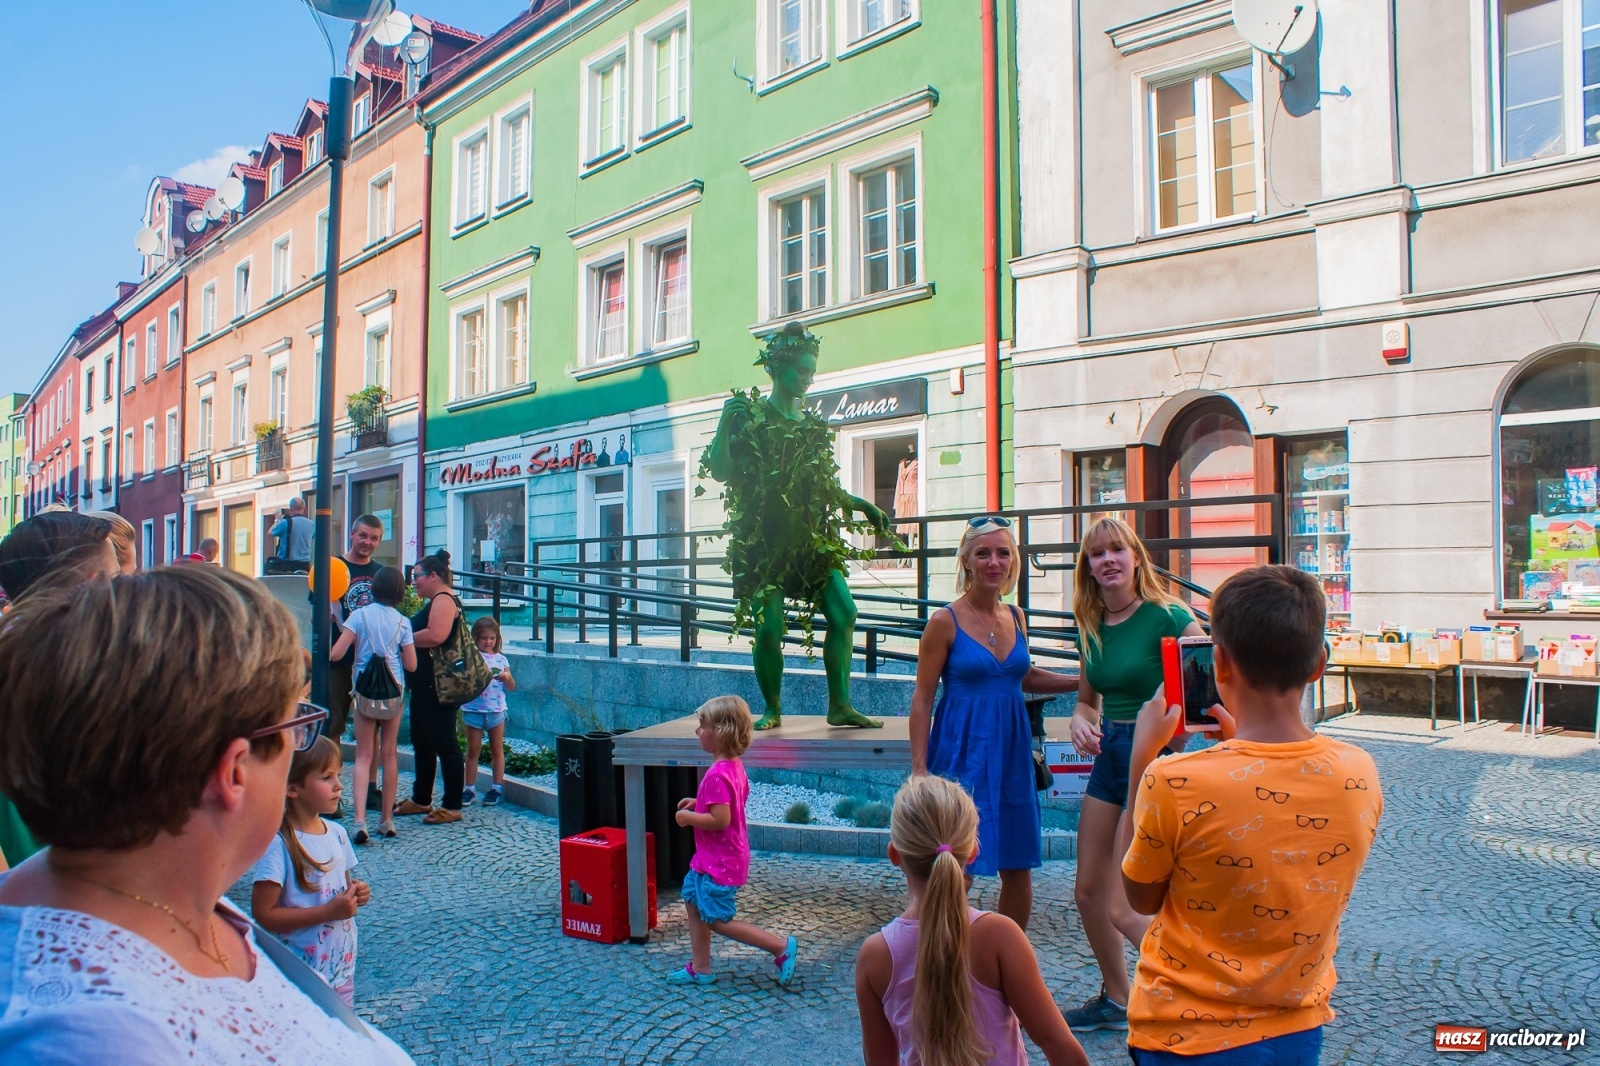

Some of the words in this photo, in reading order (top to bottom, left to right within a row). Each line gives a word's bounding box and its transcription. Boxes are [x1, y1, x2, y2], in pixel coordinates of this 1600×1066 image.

[828, 393, 899, 420] Lamar
[440, 456, 521, 485] Modna
[526, 439, 598, 474] Szafa
[566, 918, 602, 938] ŻYWIEC
